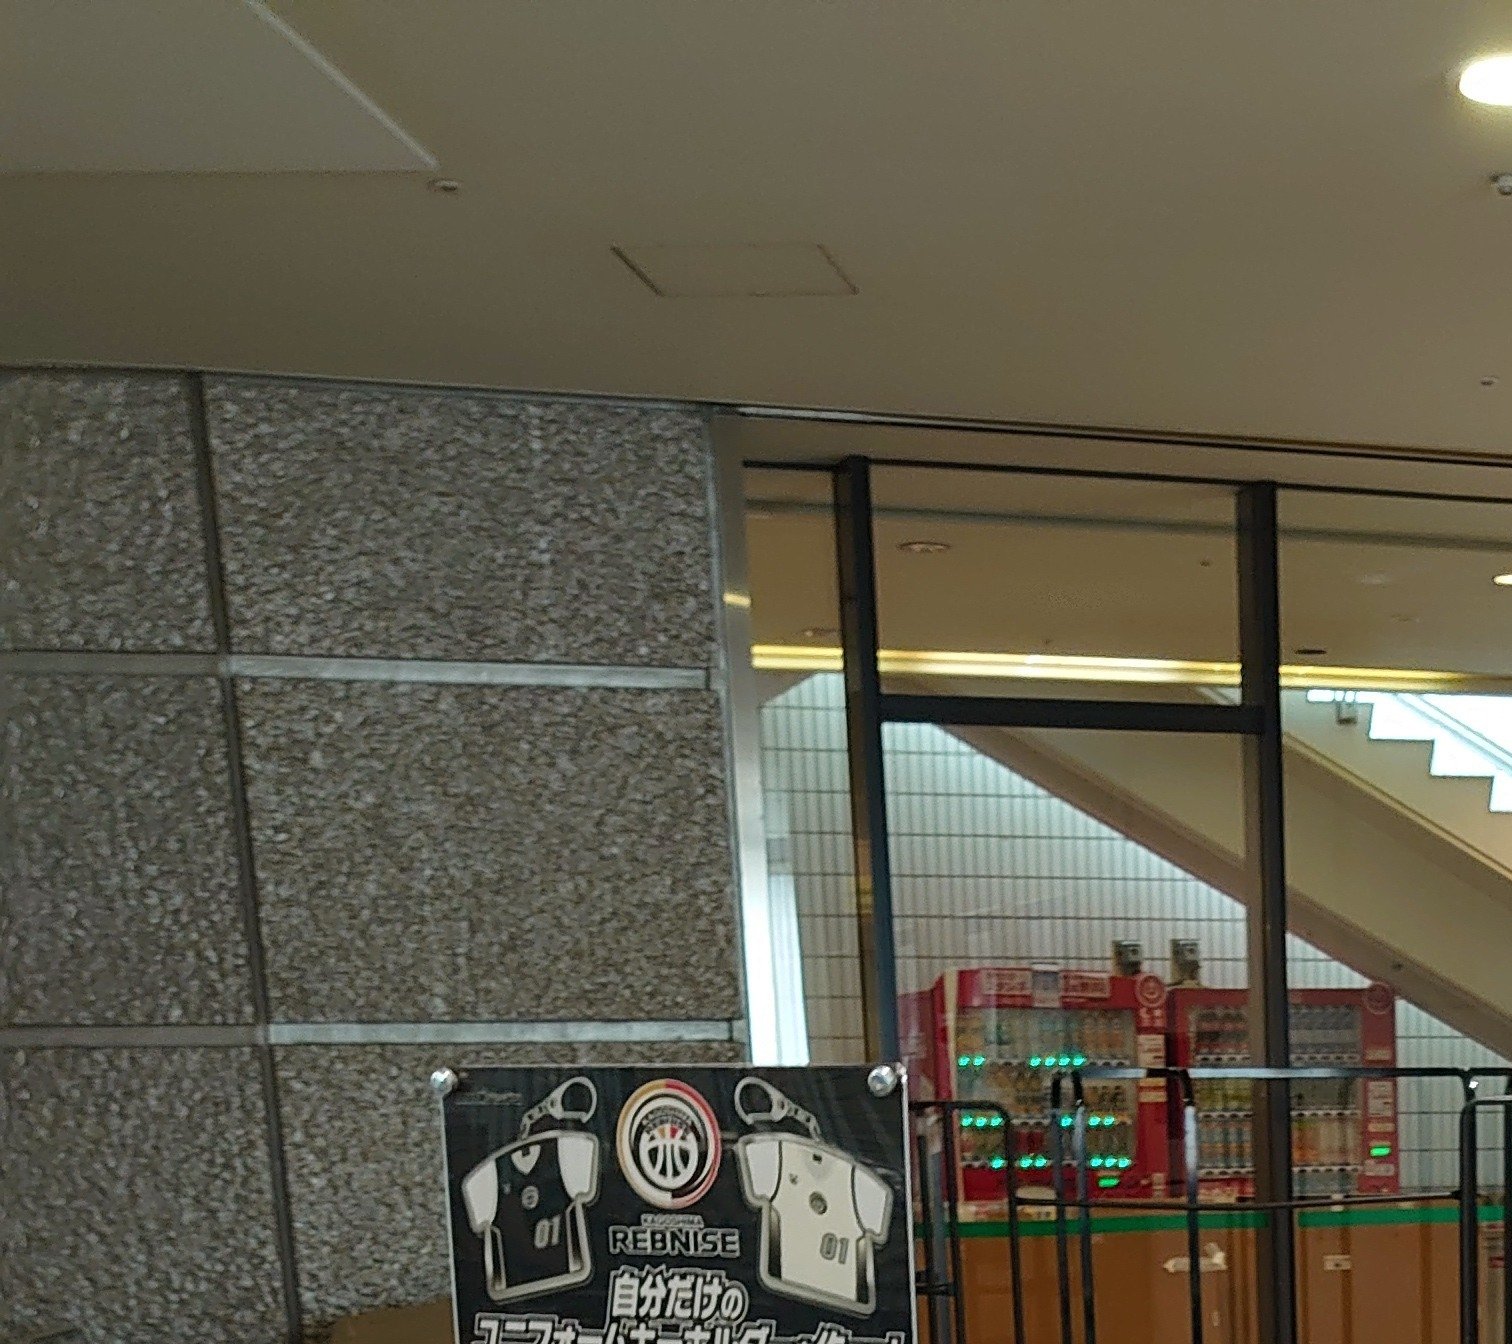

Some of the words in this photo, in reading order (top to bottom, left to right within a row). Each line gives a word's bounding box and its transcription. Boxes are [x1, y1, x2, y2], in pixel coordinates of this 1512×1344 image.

[534, 1214, 561, 1249] 01
[609, 1226, 740, 1257] REBNISE
[820, 1232, 849, 1264] 01
[612, 1272, 745, 1320] 自分だけの
